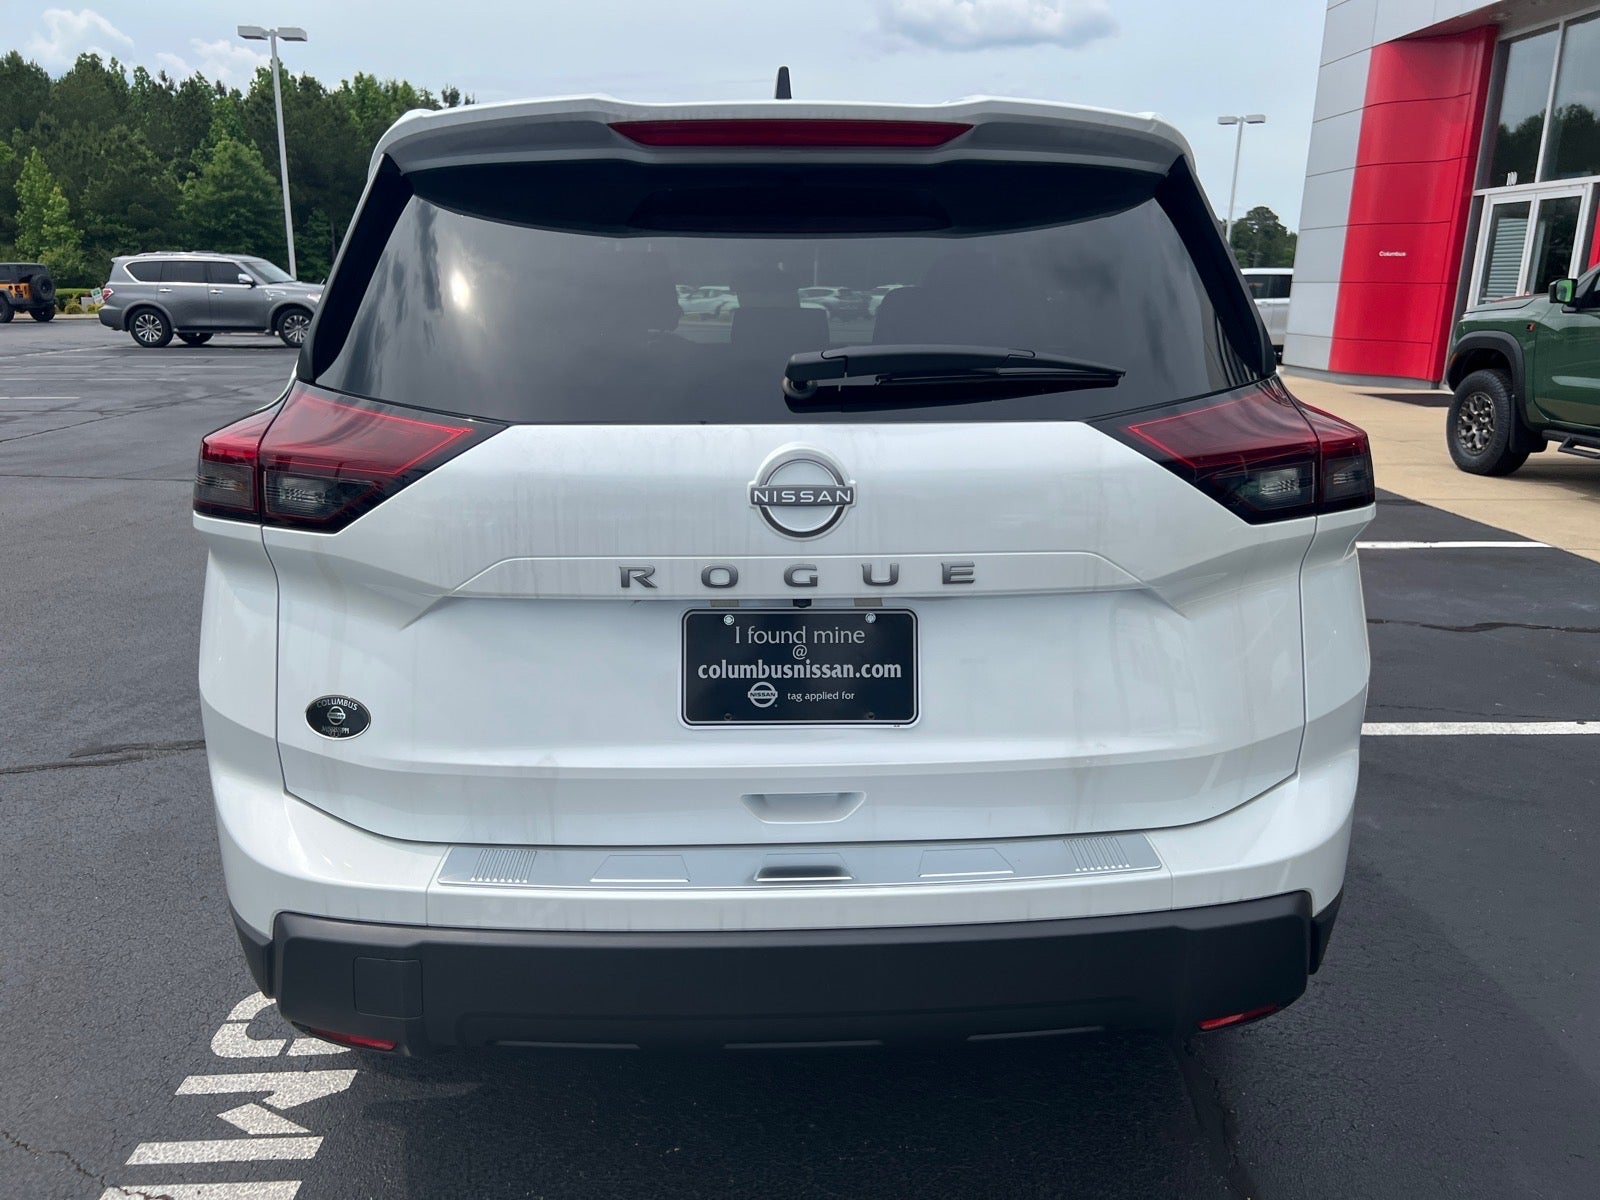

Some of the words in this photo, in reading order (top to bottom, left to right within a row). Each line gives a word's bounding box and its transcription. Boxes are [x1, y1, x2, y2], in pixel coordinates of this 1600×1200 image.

[753, 490, 851, 503] NISSAN
[619, 561, 976, 589] ROGUE
[735, 626, 741, 644] I
[747, 626, 806, 644] found
[813, 626, 866, 644] mine
[792, 644, 808, 660] @
[698, 659, 902, 679] columbusnissan.com
[316, 698, 358, 711] COLUMBUS
[787, 692, 803, 702] tag
[804, 691, 839, 702] applied
[841, 691, 855, 700] for
